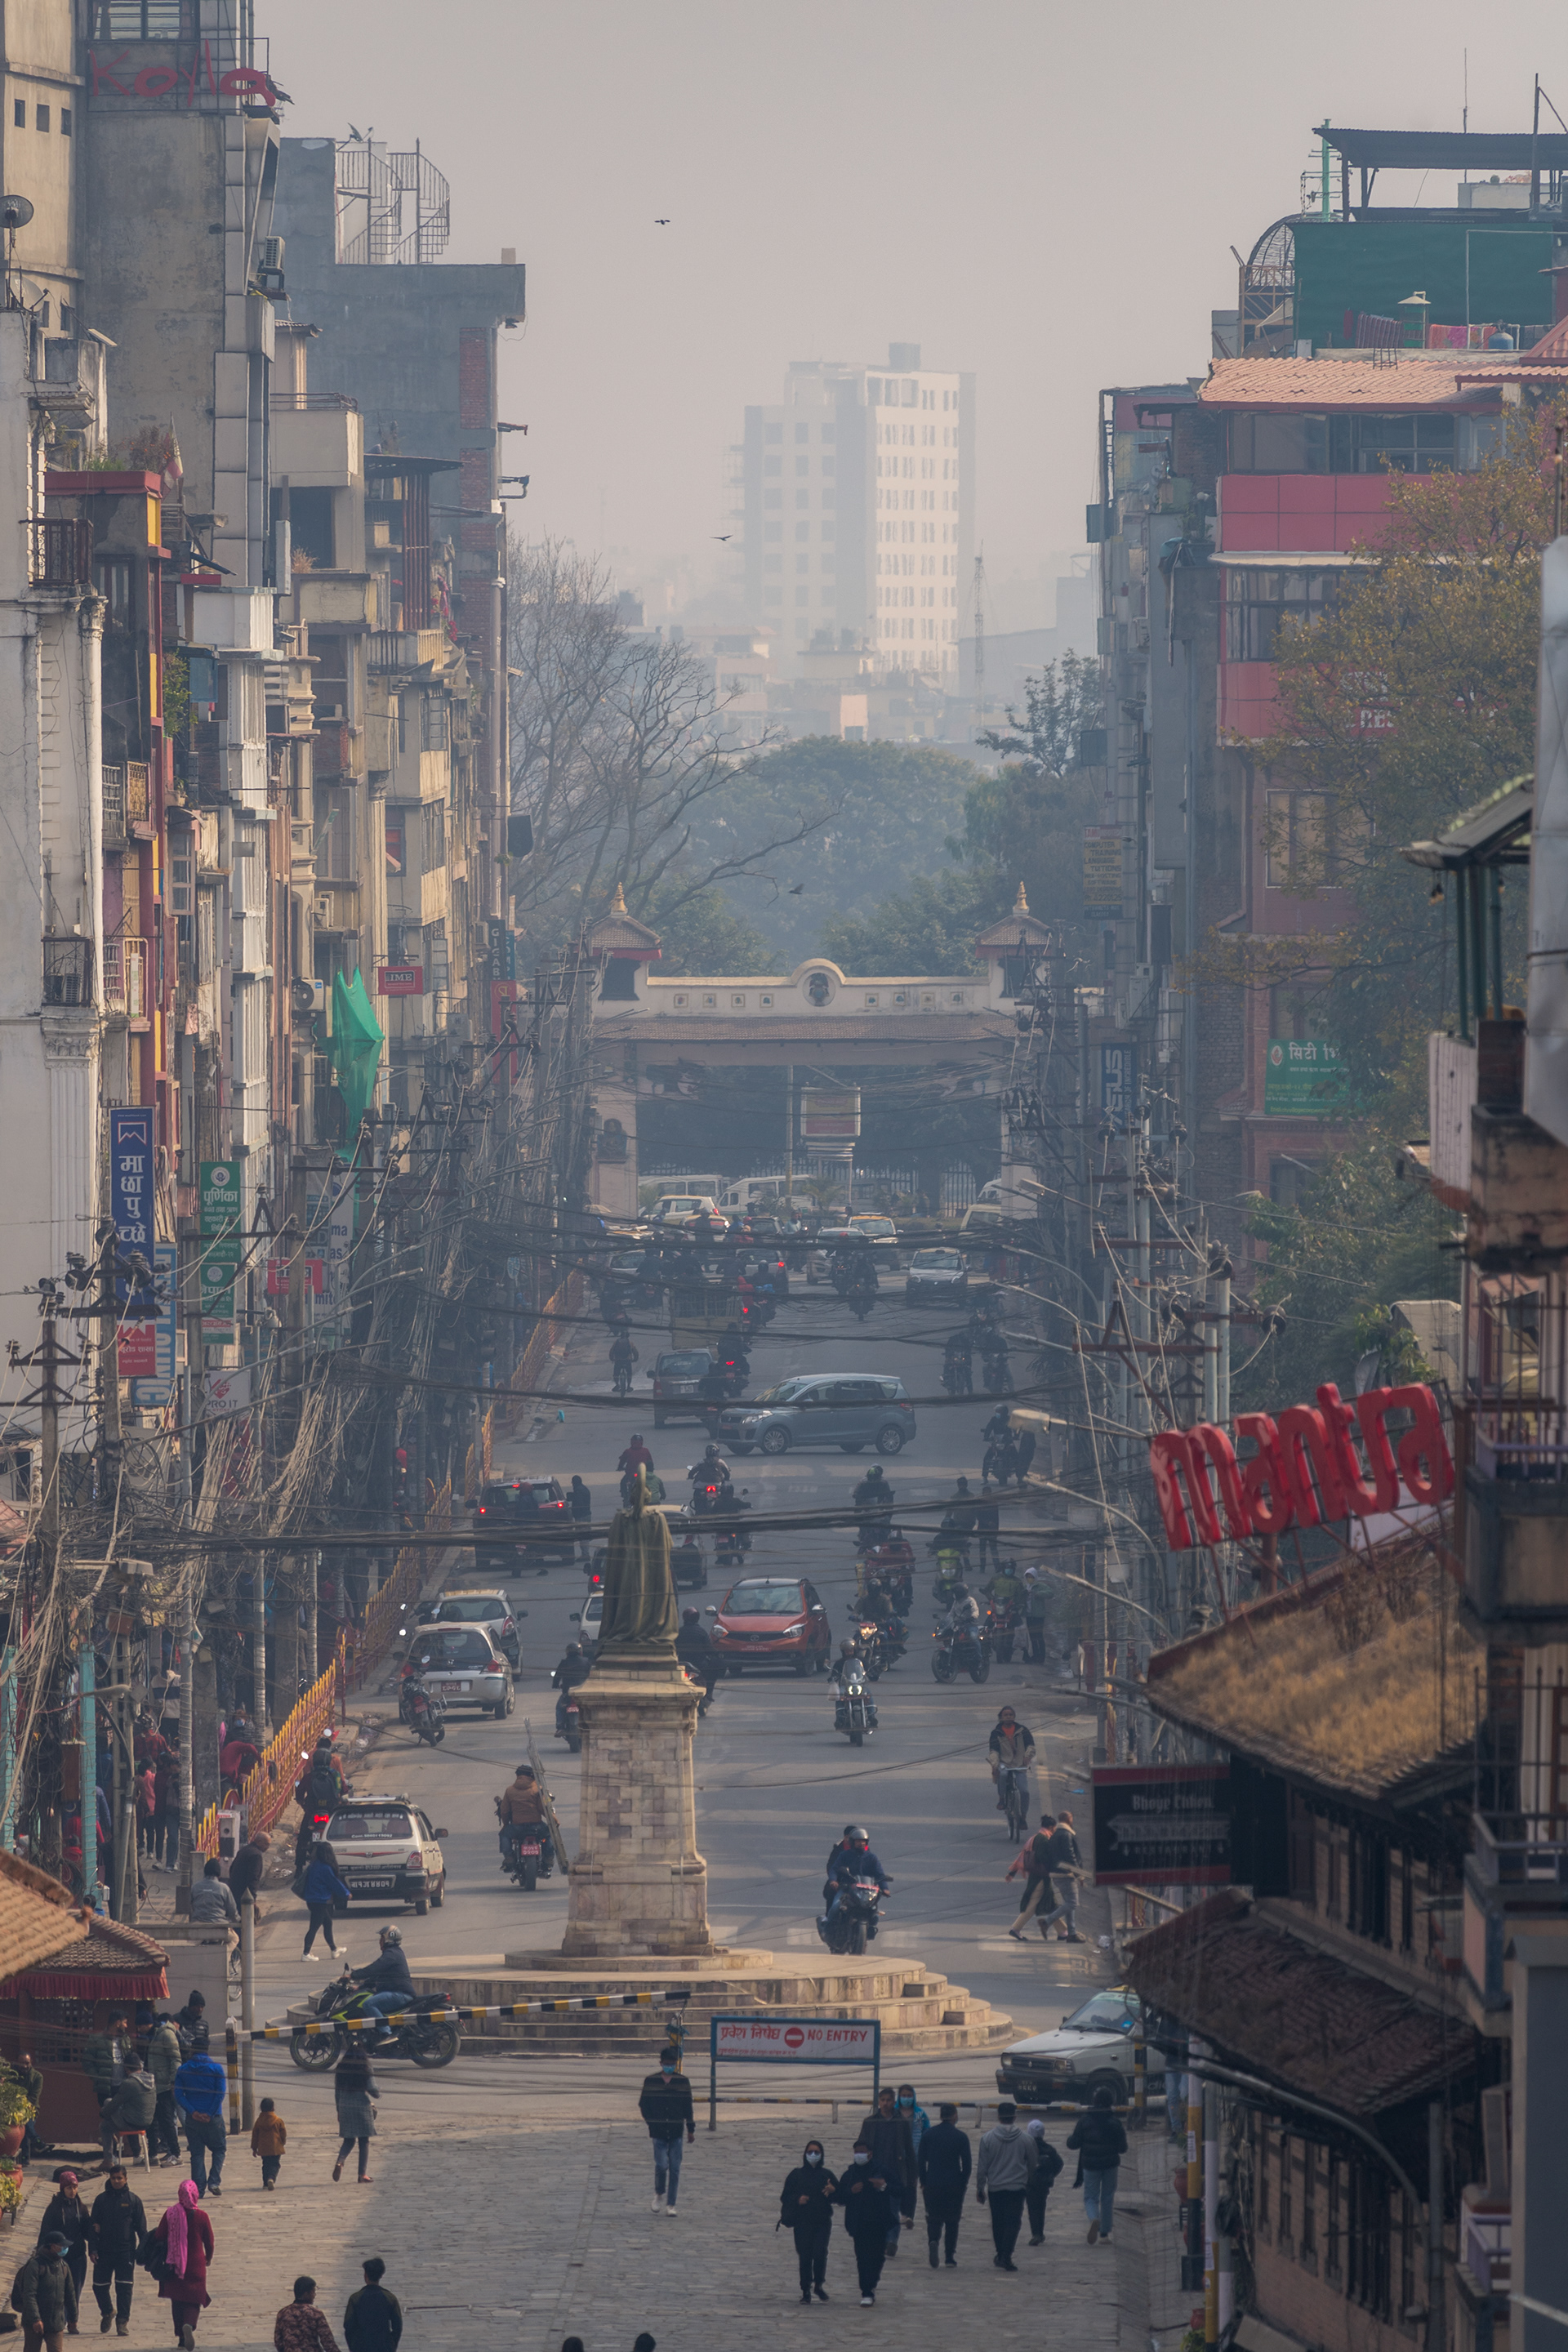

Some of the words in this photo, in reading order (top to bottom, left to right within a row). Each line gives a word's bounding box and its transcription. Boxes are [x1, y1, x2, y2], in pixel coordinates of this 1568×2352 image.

[90, 39, 276, 106] Koyla
[491, 928, 501, 979] GIGAB
[229, 1399, 238, 1408] IT
[1150, 1382, 1455, 1550] mantra
[807, 2029, 823, 2041] NO
[826, 2029, 868, 2042] ENTRY
